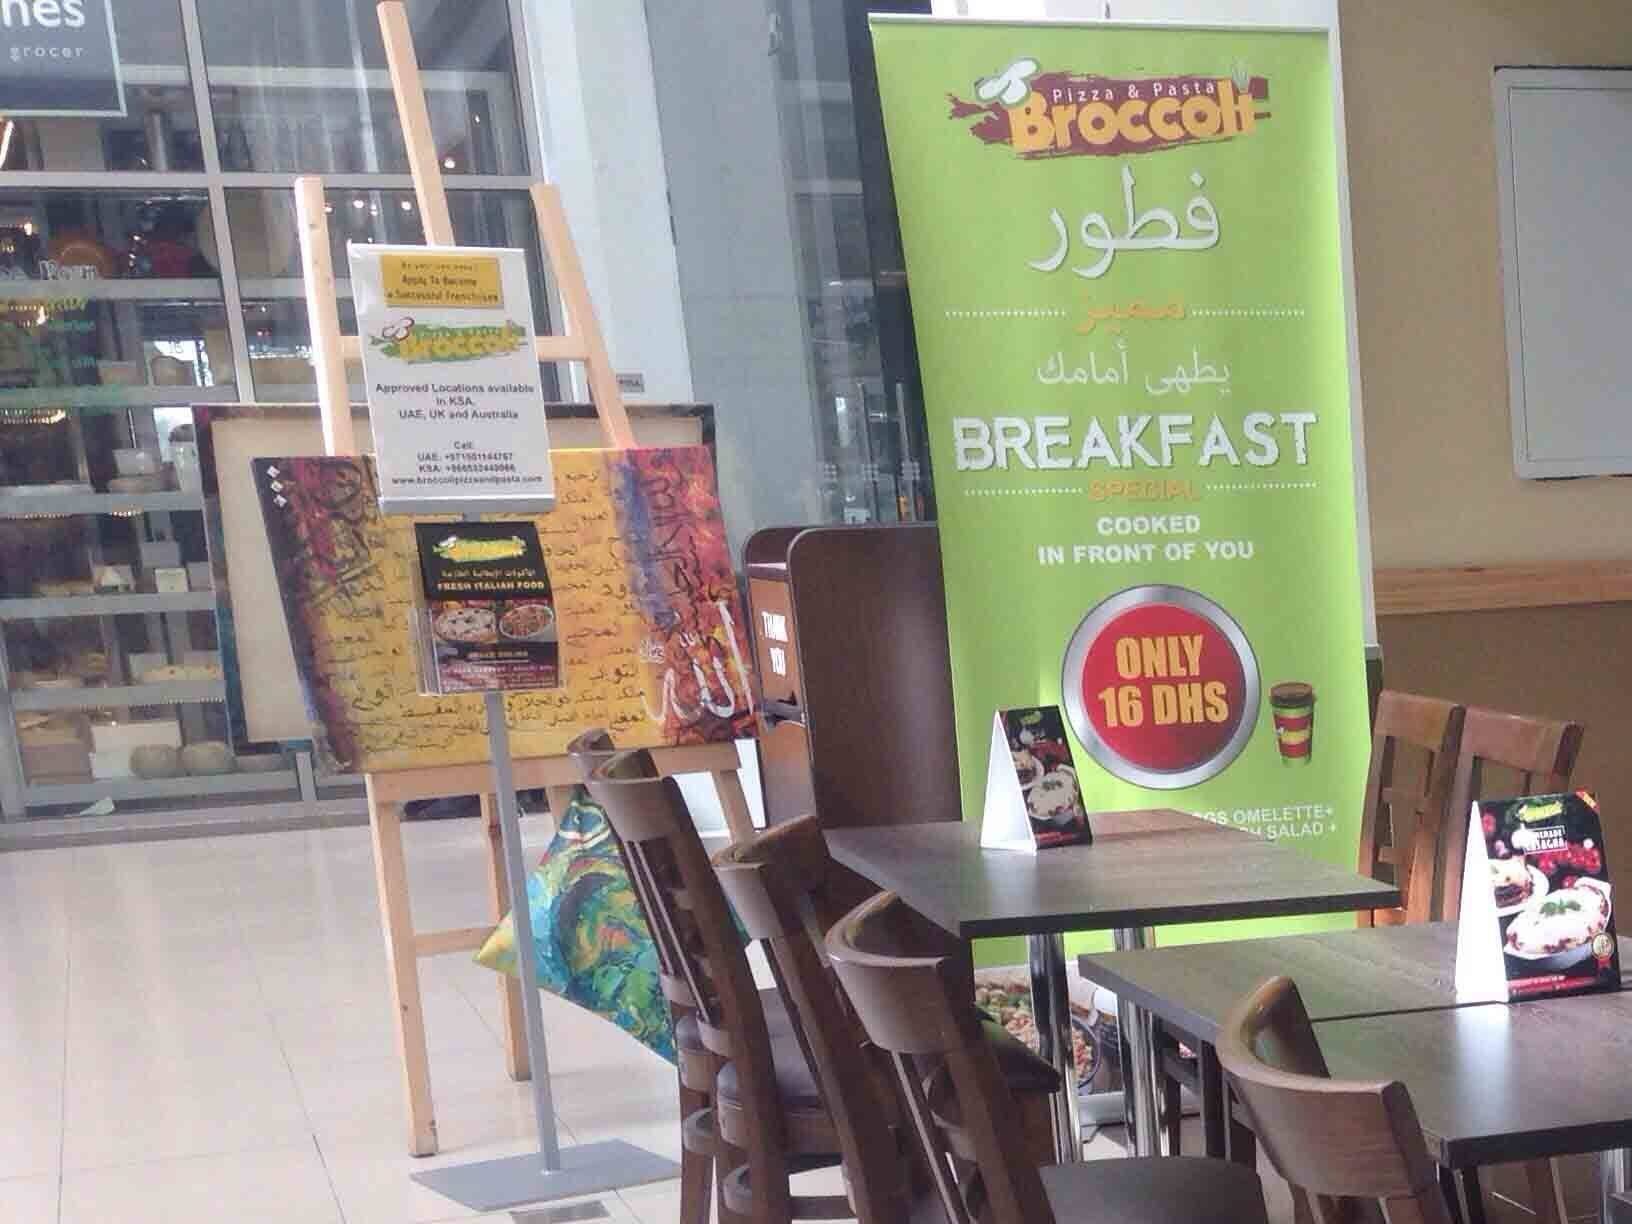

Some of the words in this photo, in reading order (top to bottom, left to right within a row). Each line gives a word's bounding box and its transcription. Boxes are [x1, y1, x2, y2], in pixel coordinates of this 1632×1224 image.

[9, 47, 84, 62] grocer
[1052, 88, 1113, 104] Pizza
[1127, 84, 1139, 98] &
[1153, 80, 1215, 97] Pasta
[1024, 163, 1222, 279] فطور
[376, 383, 429, 395] Approved
[432, 383, 485, 393] Locations
[487, 383, 535, 393] available
[399, 410, 427, 421] UAE,
[429, 410, 446, 419] UK
[449, 410, 468, 419] and
[471, 410, 519, 420] Australia
[952, 411, 1319, 471] BREAKFAST
[1088, 479, 1202, 502] SPECIAL
[1097, 514, 1201, 537] COOKED
[1038, 545, 1065, 566] IN
[1072, 543, 1157, 564] FRONT
[1165, 542, 1197, 562] OF
[1205, 540, 1255, 560] YOU
[437, 581, 472, 591] FRESH
[474, 581, 514, 591] ITALIAN
[517, 580, 545, 590] FOOD
[1115, 634, 1205, 679] ONLY
[1098, 685, 1143, 728] 16
[1151, 681, 1230, 726] DHS
[1266, 821, 1324, 840] SALAD
